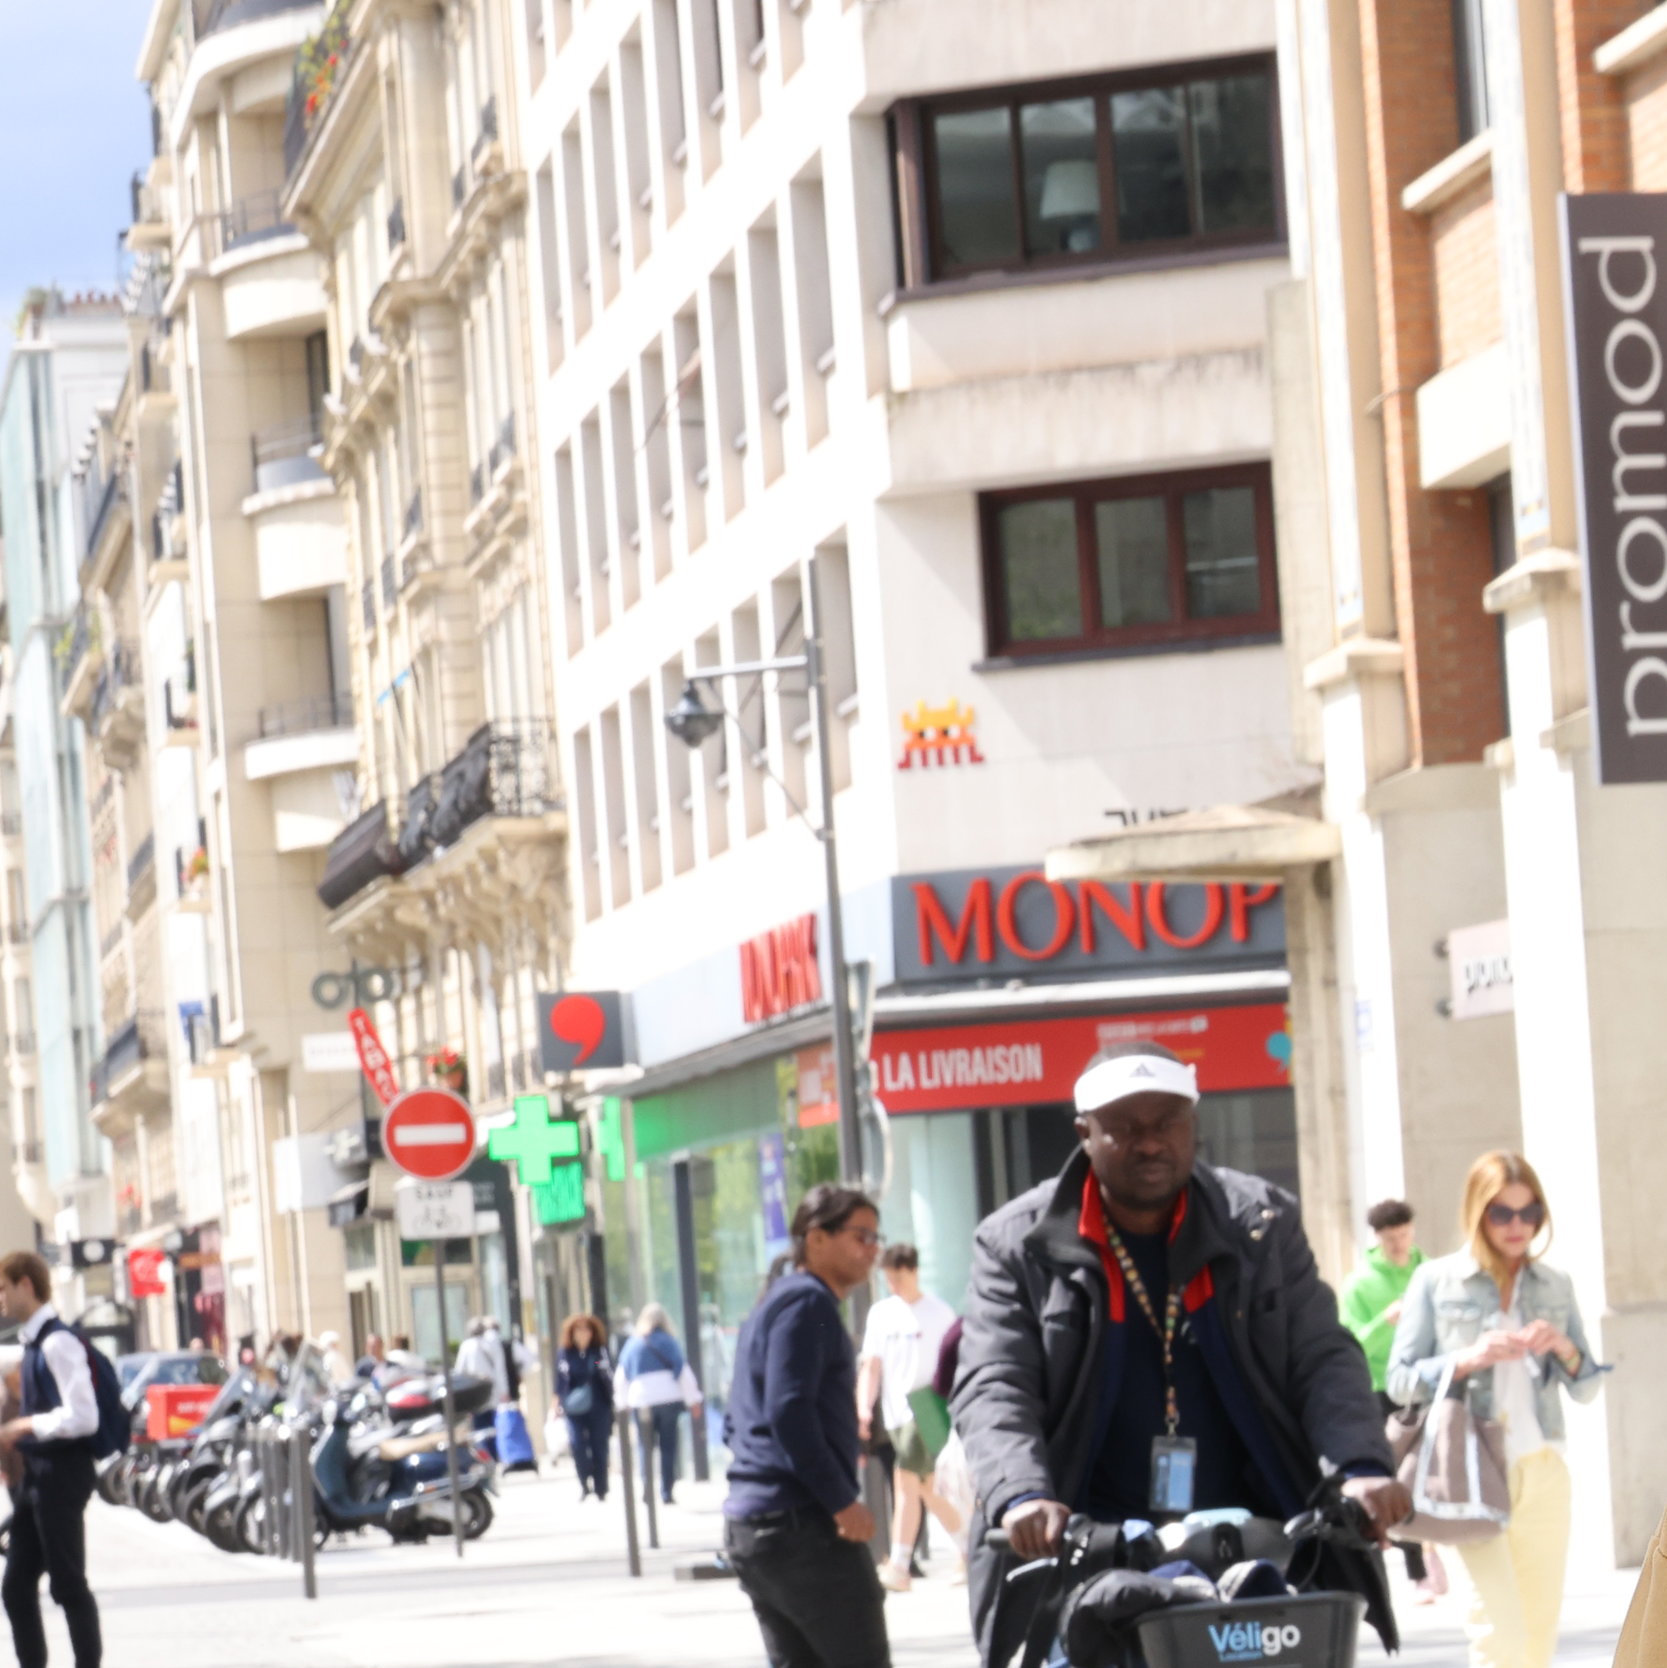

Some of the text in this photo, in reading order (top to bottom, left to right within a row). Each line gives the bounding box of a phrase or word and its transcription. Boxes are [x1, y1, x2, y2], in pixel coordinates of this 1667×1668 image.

[883, 1052, 916, 1091] LA
[918, 1044, 1044, 1090] LIVRAISON
[1207, 1620, 1301, 1656] Véligo
